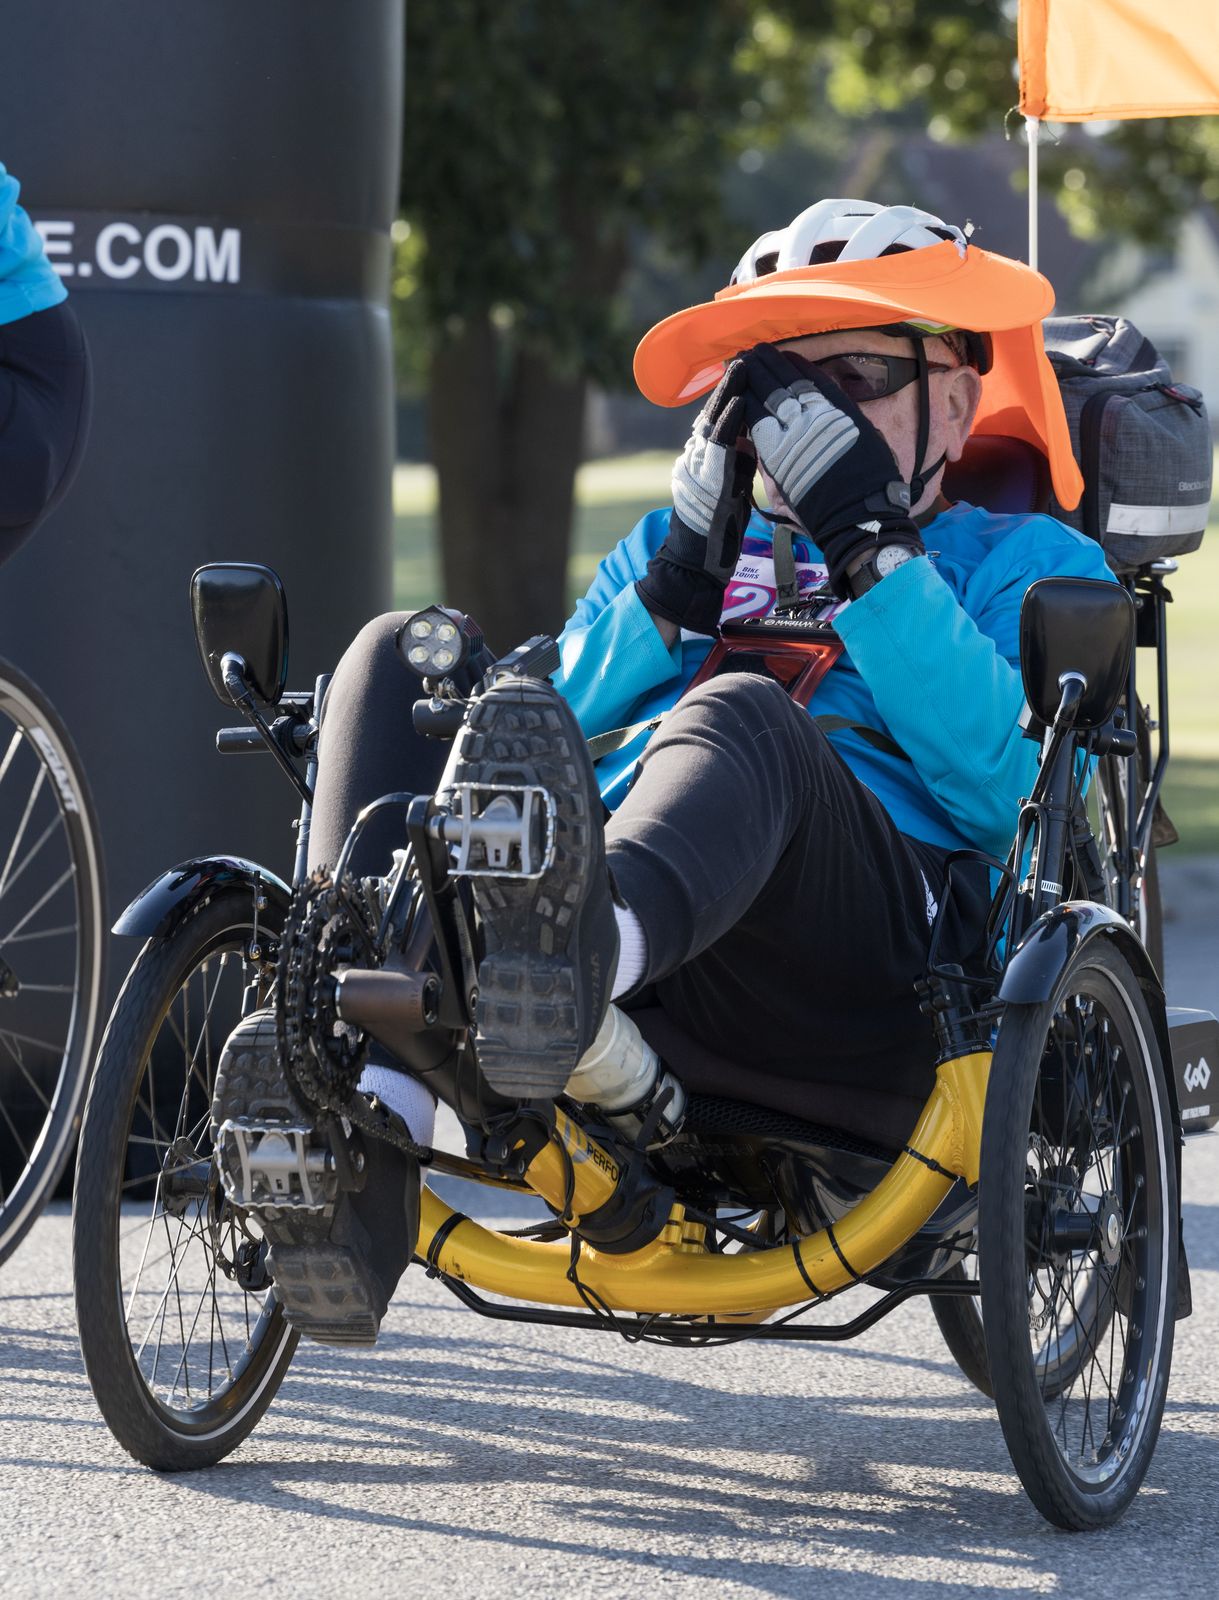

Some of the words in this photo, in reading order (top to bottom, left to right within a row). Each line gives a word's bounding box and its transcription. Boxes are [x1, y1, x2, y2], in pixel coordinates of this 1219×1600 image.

[741, 566, 760, 574] BIKE
[735, 571, 760, 579] TOURS
[775, 619, 815, 628] MAGELLAN
